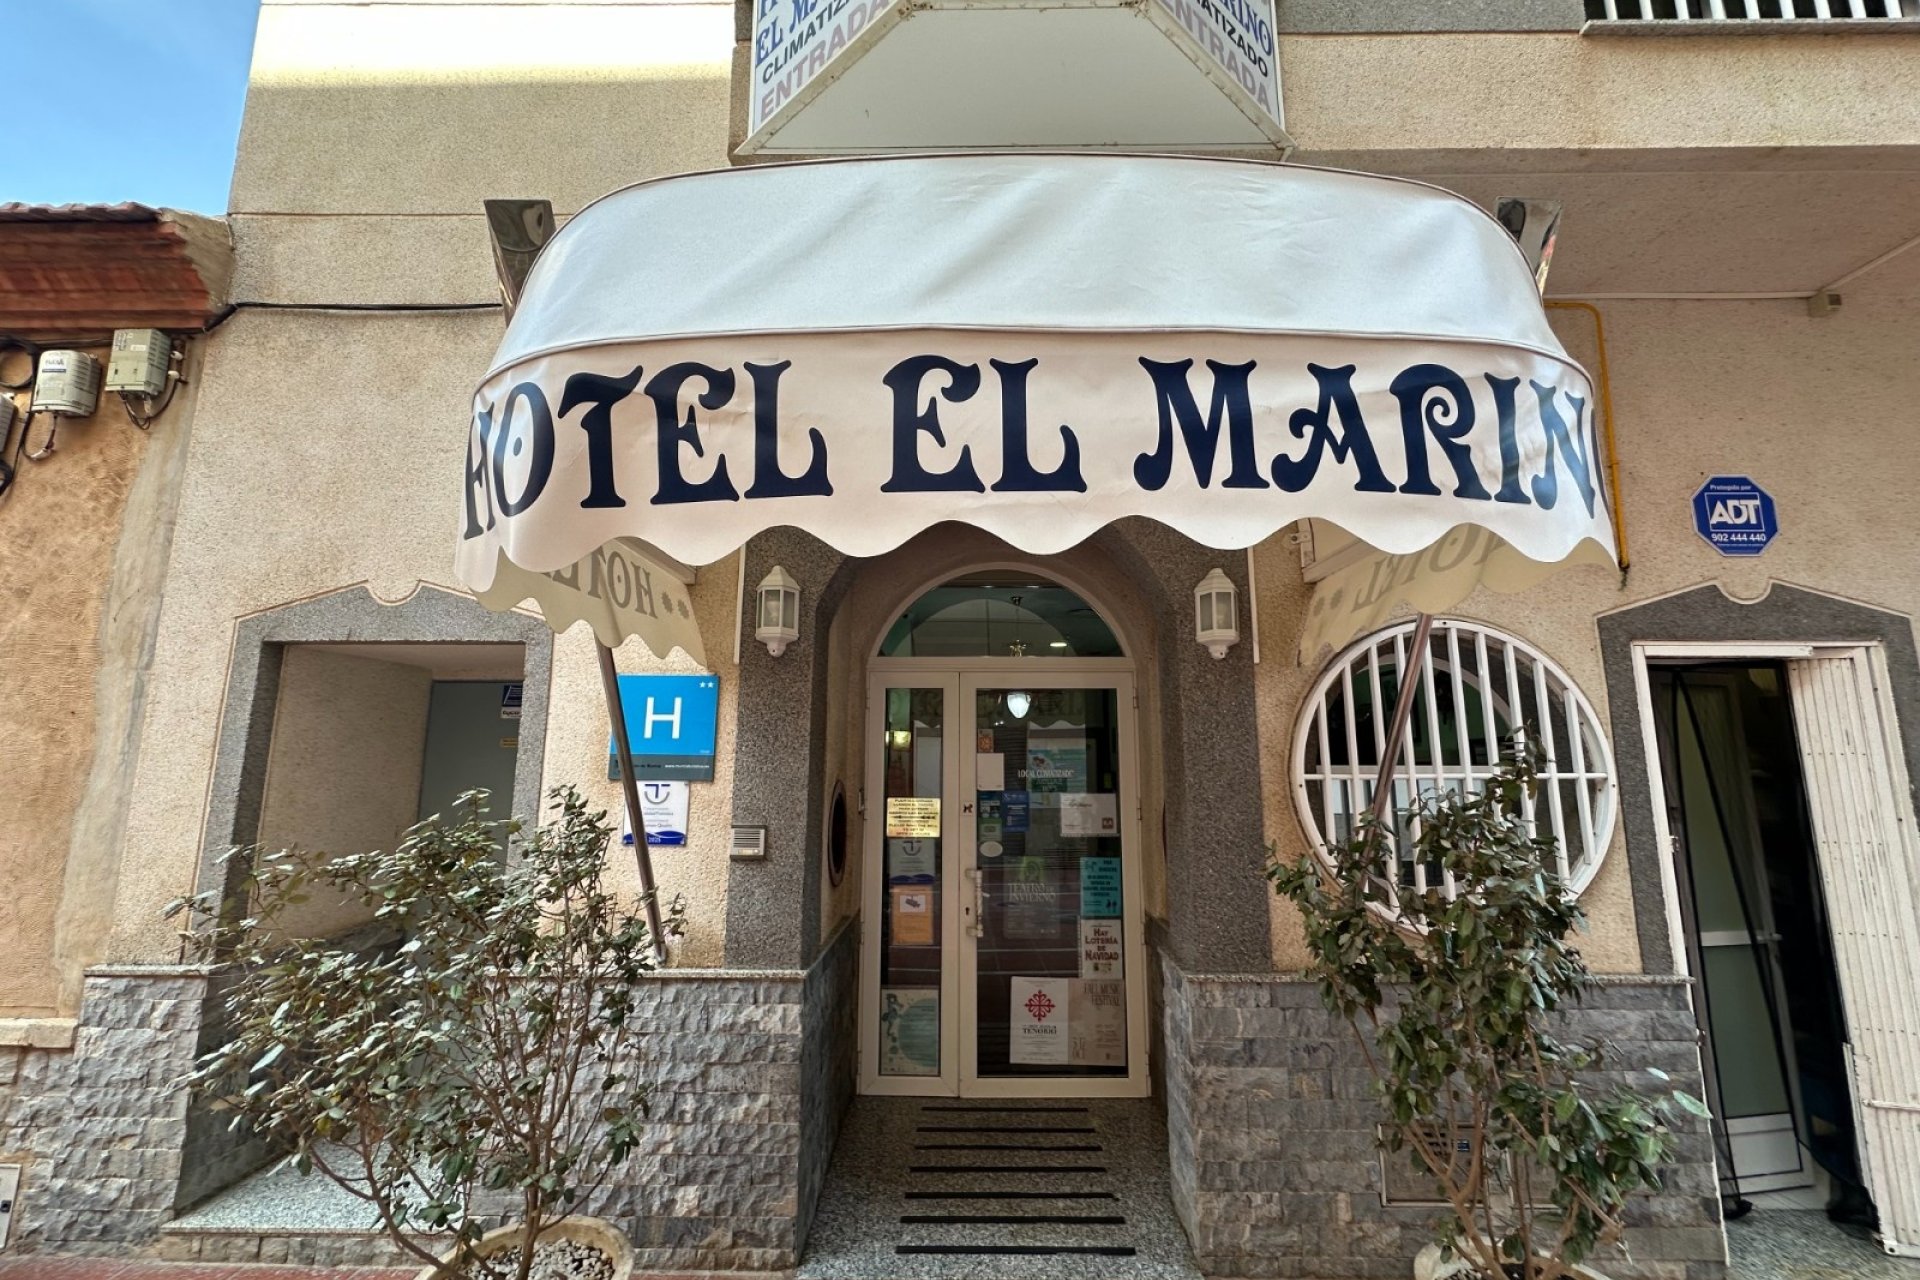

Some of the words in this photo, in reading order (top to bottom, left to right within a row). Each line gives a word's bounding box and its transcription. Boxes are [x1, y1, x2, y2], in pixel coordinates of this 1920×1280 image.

[756, 16, 783, 67] EL
[762, 0, 850, 84] CLIMATIZ
[1197, 0, 1268, 78] ATIZADO
[463, 359, 834, 540] HOTEL
[880, 354, 1088, 494] EL
[1133, 355, 1611, 521] MARIN
[1710, 499, 1760, 525] ADT
[1711, 533, 1729, 542] 902
[1730, 533, 1748, 542] 444
[1749, 533, 1767, 542] 440
[643, 696, 683, 740] H
[1085, 950, 1119, 960] NAVIDAD
